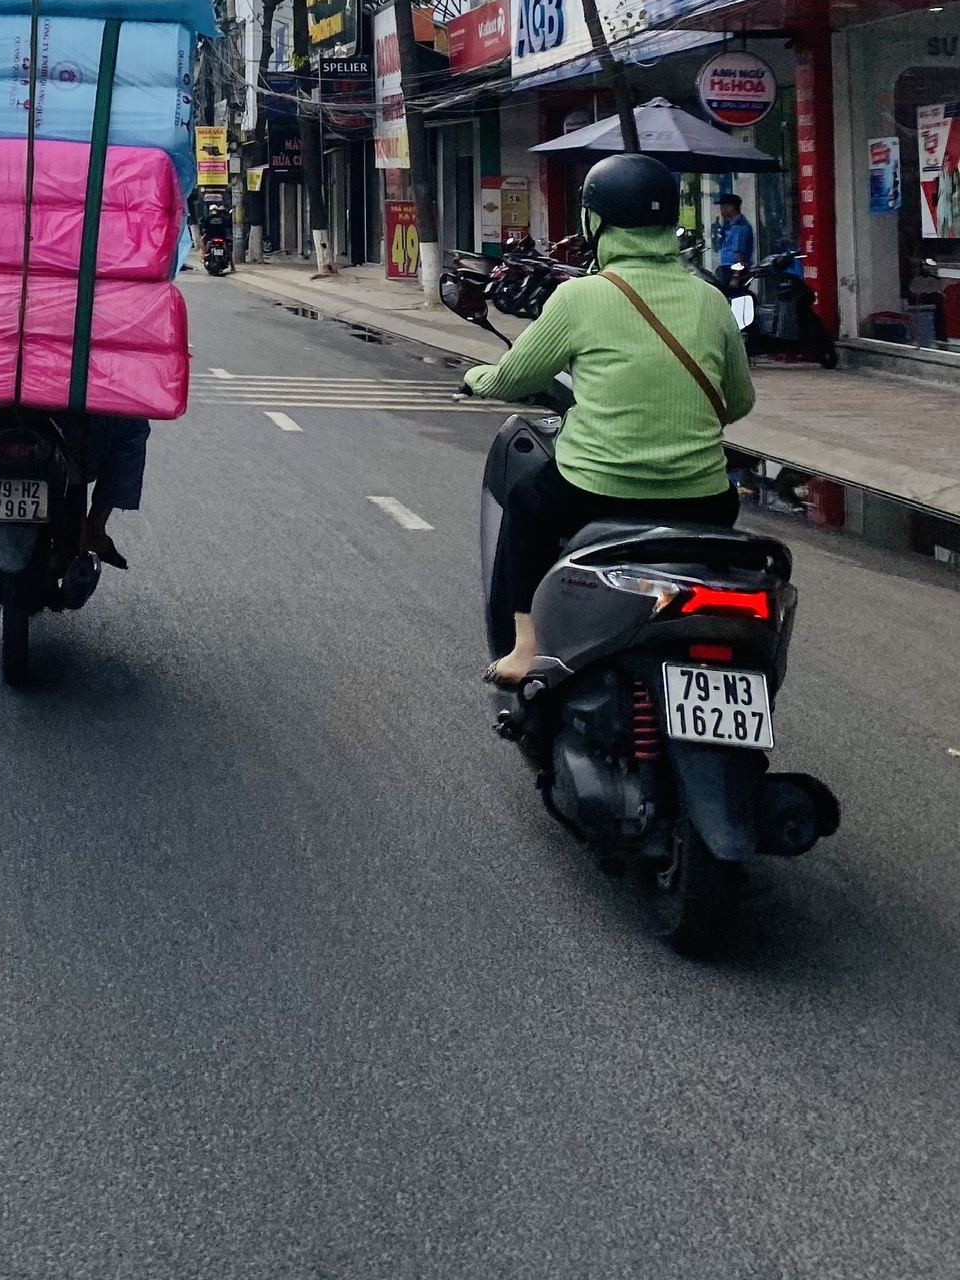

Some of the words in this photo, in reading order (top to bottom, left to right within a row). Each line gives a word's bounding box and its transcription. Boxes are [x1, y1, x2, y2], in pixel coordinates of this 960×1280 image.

[42, 18, 51, 40] CÔNG
[42, 42, 49, 54] TY
[41, 55, 49, 78] TNHH
[323, 62, 368, 72] SPELIER
[712, 69, 737, 78] ANH
[38, 79, 47, 105] QUANG
[680, 669, 753, 706] 79-N3
[675, 703, 764, 742] 162.87
